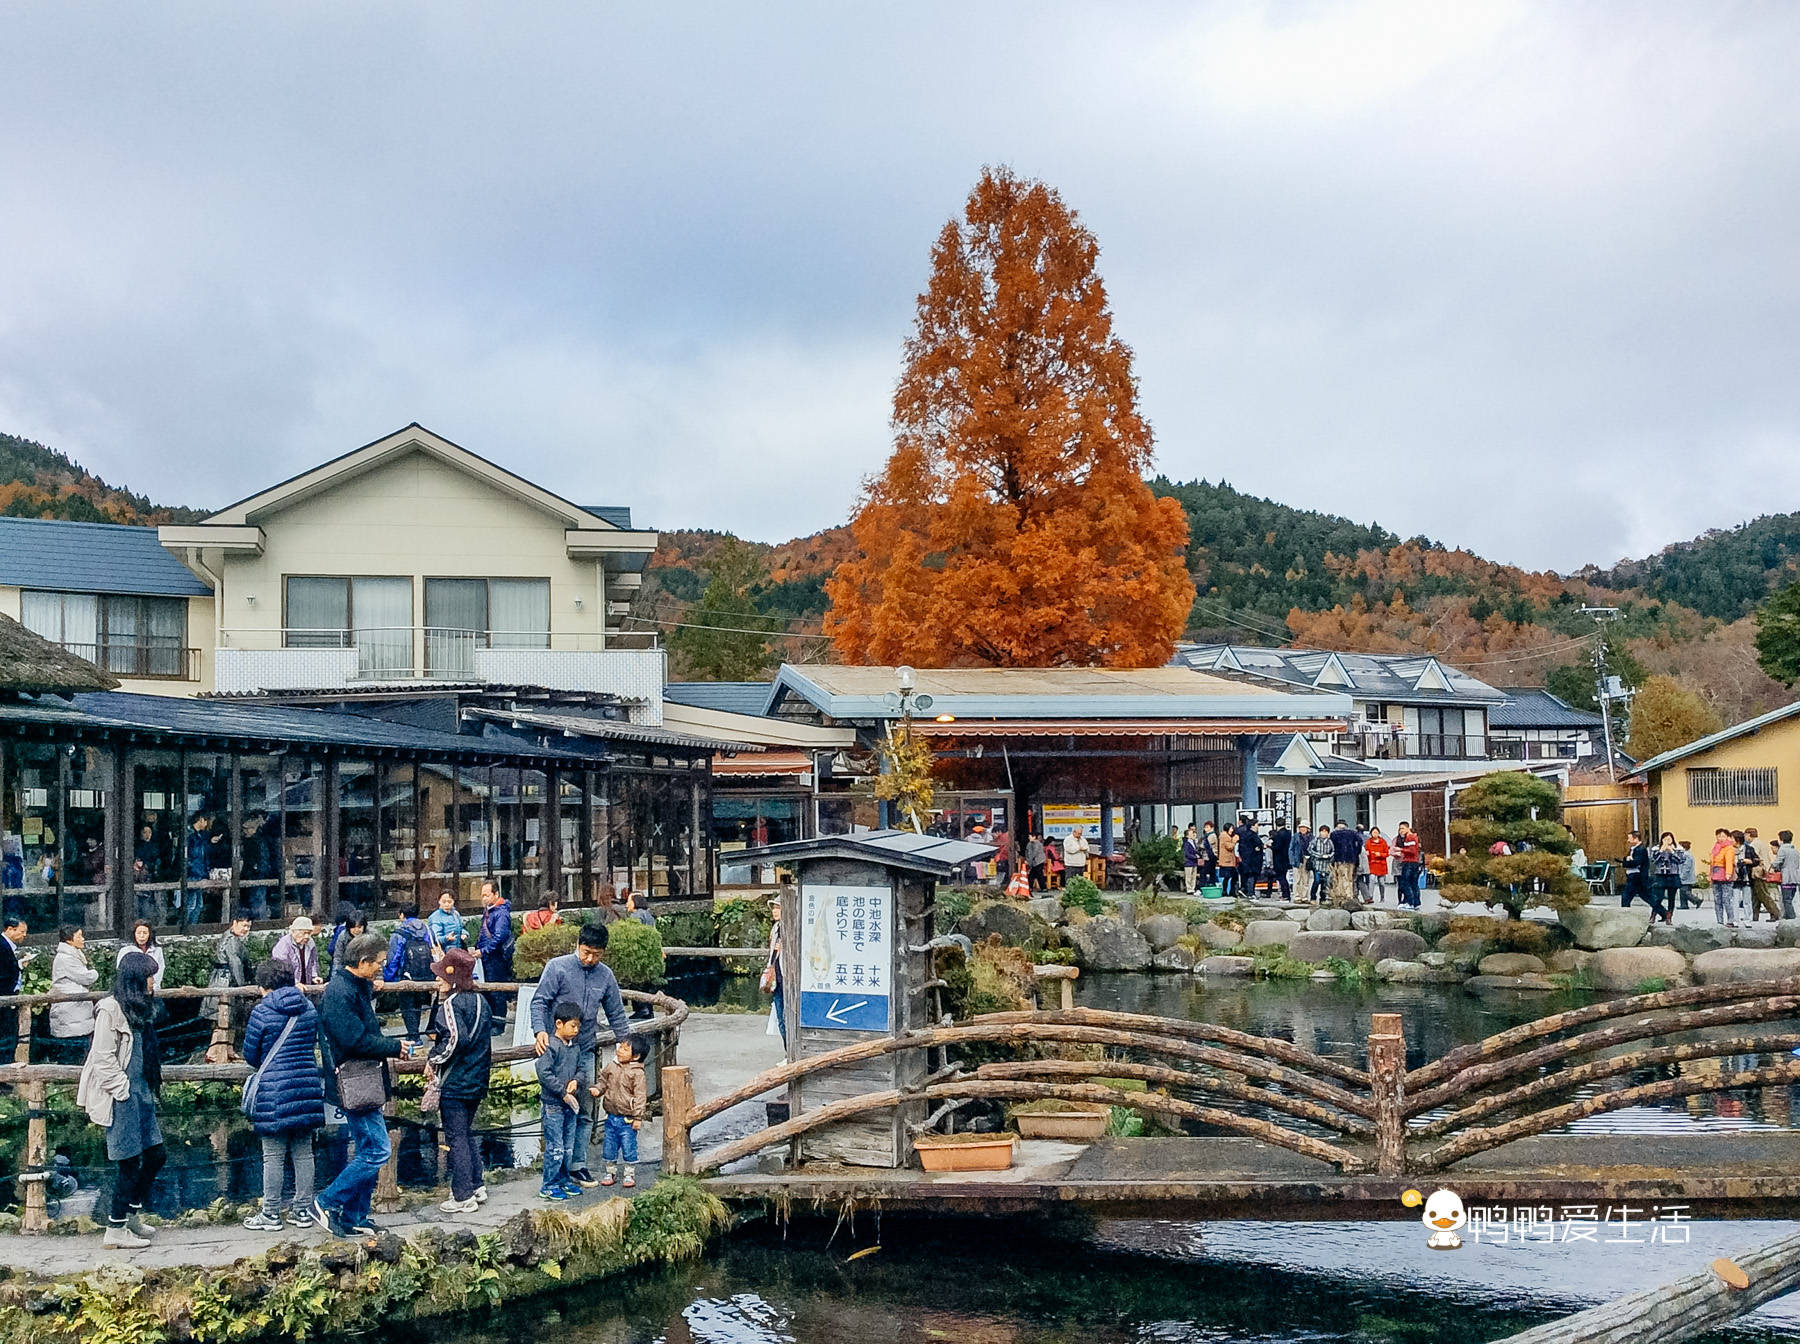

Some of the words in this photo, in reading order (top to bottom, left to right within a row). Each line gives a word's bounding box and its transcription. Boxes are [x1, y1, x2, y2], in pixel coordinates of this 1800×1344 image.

[836, 896, 848, 940] 底より下
[852, 896, 865, 952] 池の底まで
[869, 897, 881, 942] 中池水深
[836, 963, 847, 985] 五米
[852, 964, 864, 985] 五米
[869, 965, 880, 987] 十米
